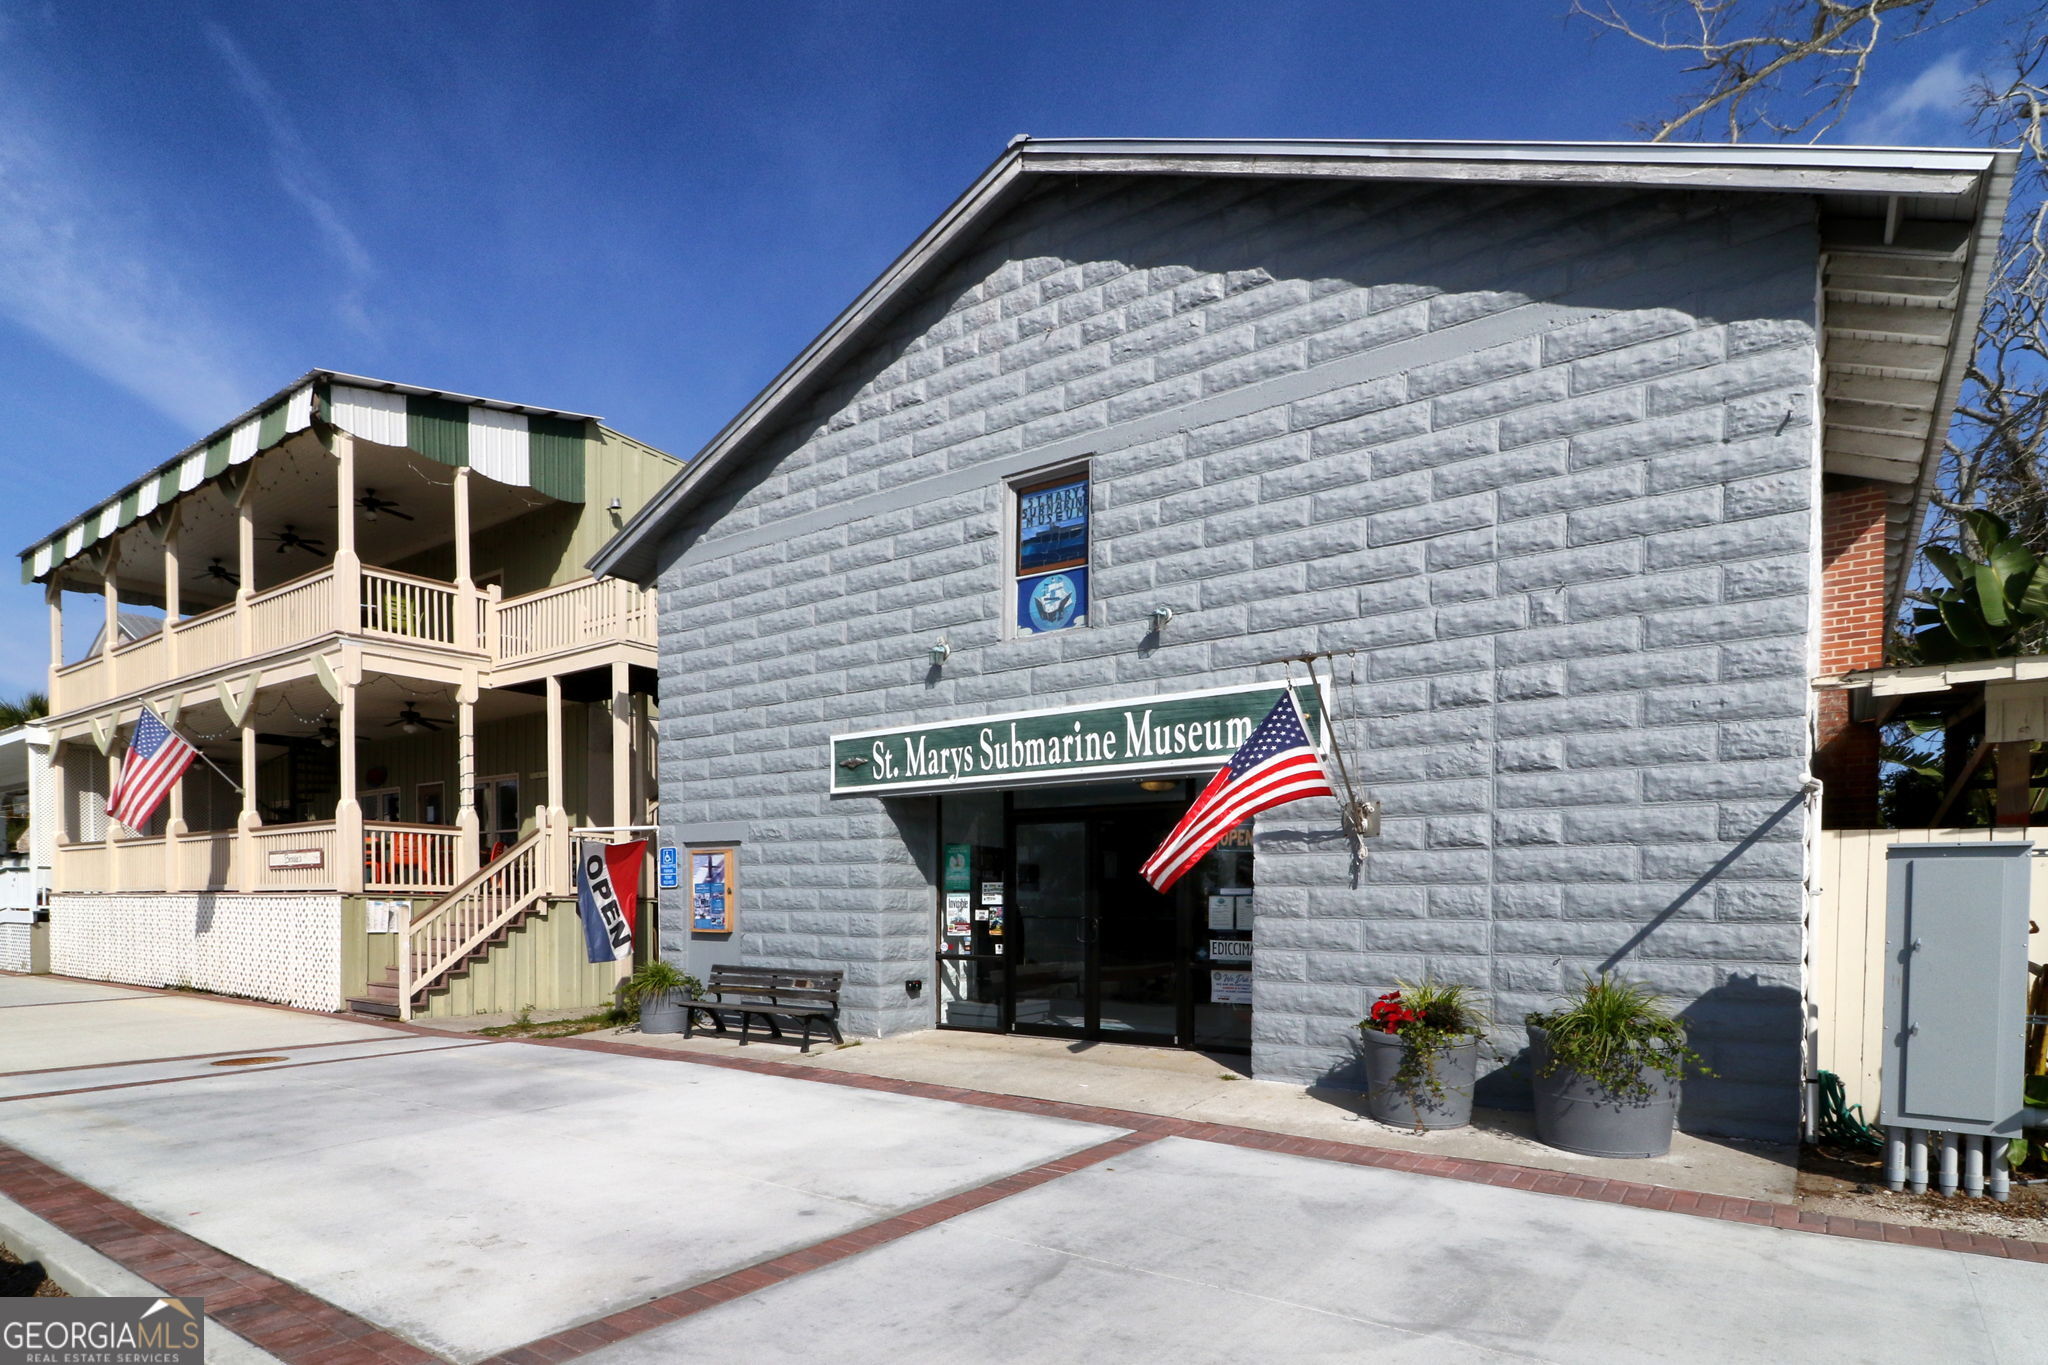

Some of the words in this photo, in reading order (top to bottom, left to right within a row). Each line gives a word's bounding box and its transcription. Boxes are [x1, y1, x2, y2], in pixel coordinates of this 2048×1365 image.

[1026, 506, 1084, 529] MUSEUM
[872, 740, 899, 780] St.
[904, 735, 974, 783] Marys
[979, 720, 1117, 771] Submarine
[1124, 709, 1252, 758] Museum
[1220, 829, 1253, 847] OPEN
[586, 854, 632, 950] OPEN
